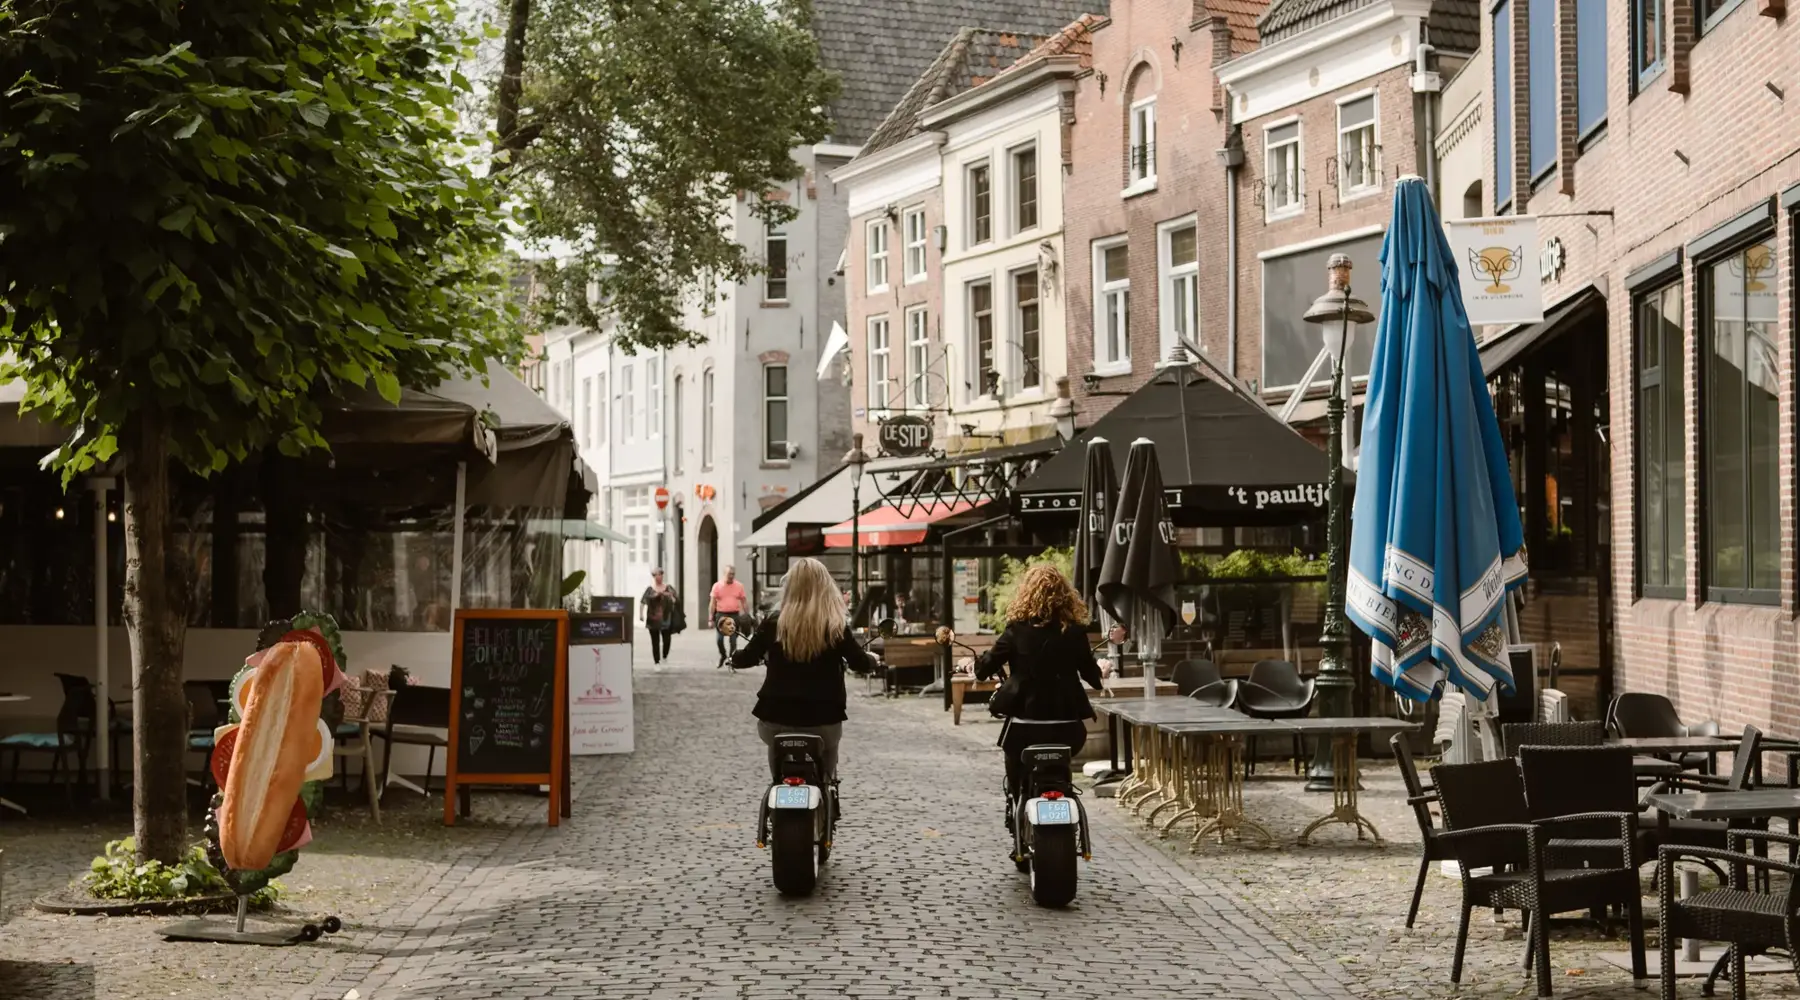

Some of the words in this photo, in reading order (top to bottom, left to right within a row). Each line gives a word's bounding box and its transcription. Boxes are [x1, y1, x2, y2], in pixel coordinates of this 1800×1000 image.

[1540, 237, 1560, 280] ultje
[884, 425, 897, 440] DE
[1020, 496, 1077, 510] Proe
[1393, 562, 1415, 581] NG
